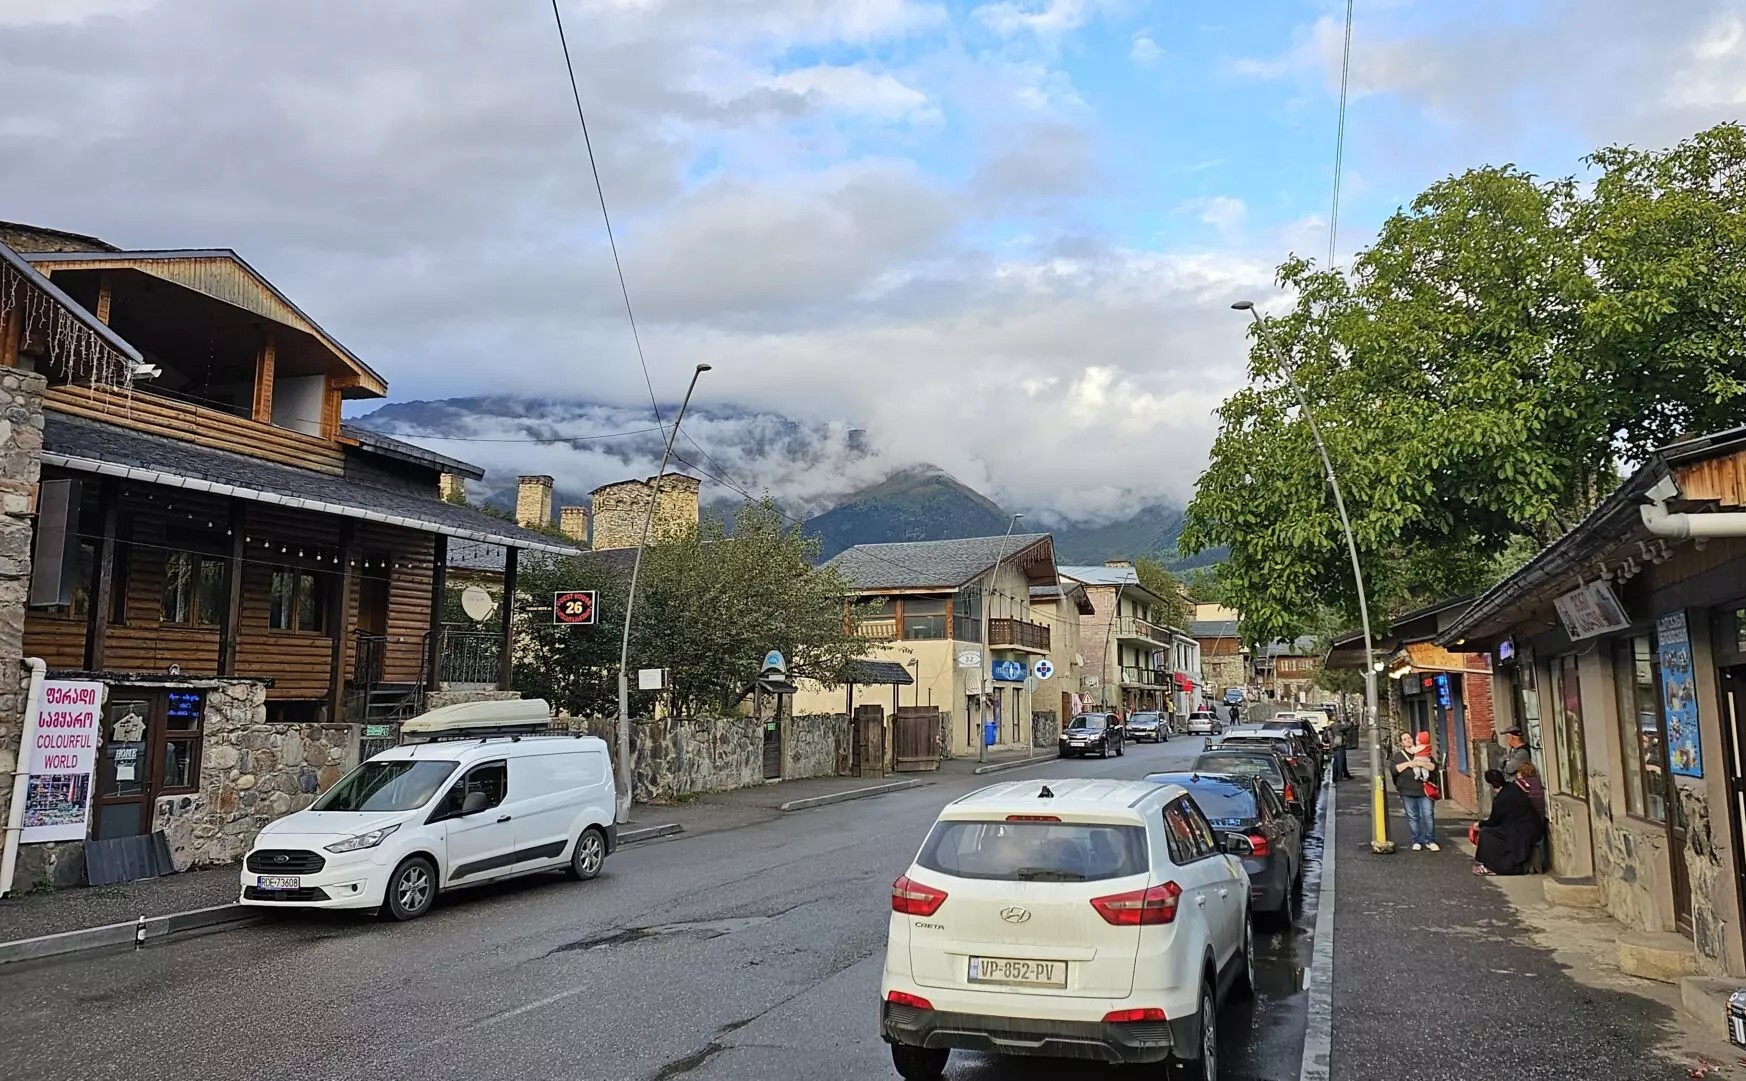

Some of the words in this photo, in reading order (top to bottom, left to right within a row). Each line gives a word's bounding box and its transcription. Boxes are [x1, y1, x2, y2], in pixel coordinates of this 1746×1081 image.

[565, 601, 583, 614] 26
[46, 687, 96, 705] ფერადი
[38, 711, 93, 728] სამყარო
[36, 734, 91, 749] COLOURFUL
[44, 754, 78, 769] WORLD
[914, 921, 945, 930] CRETA
[981, 959, 1054, 981] VP-852-PV
